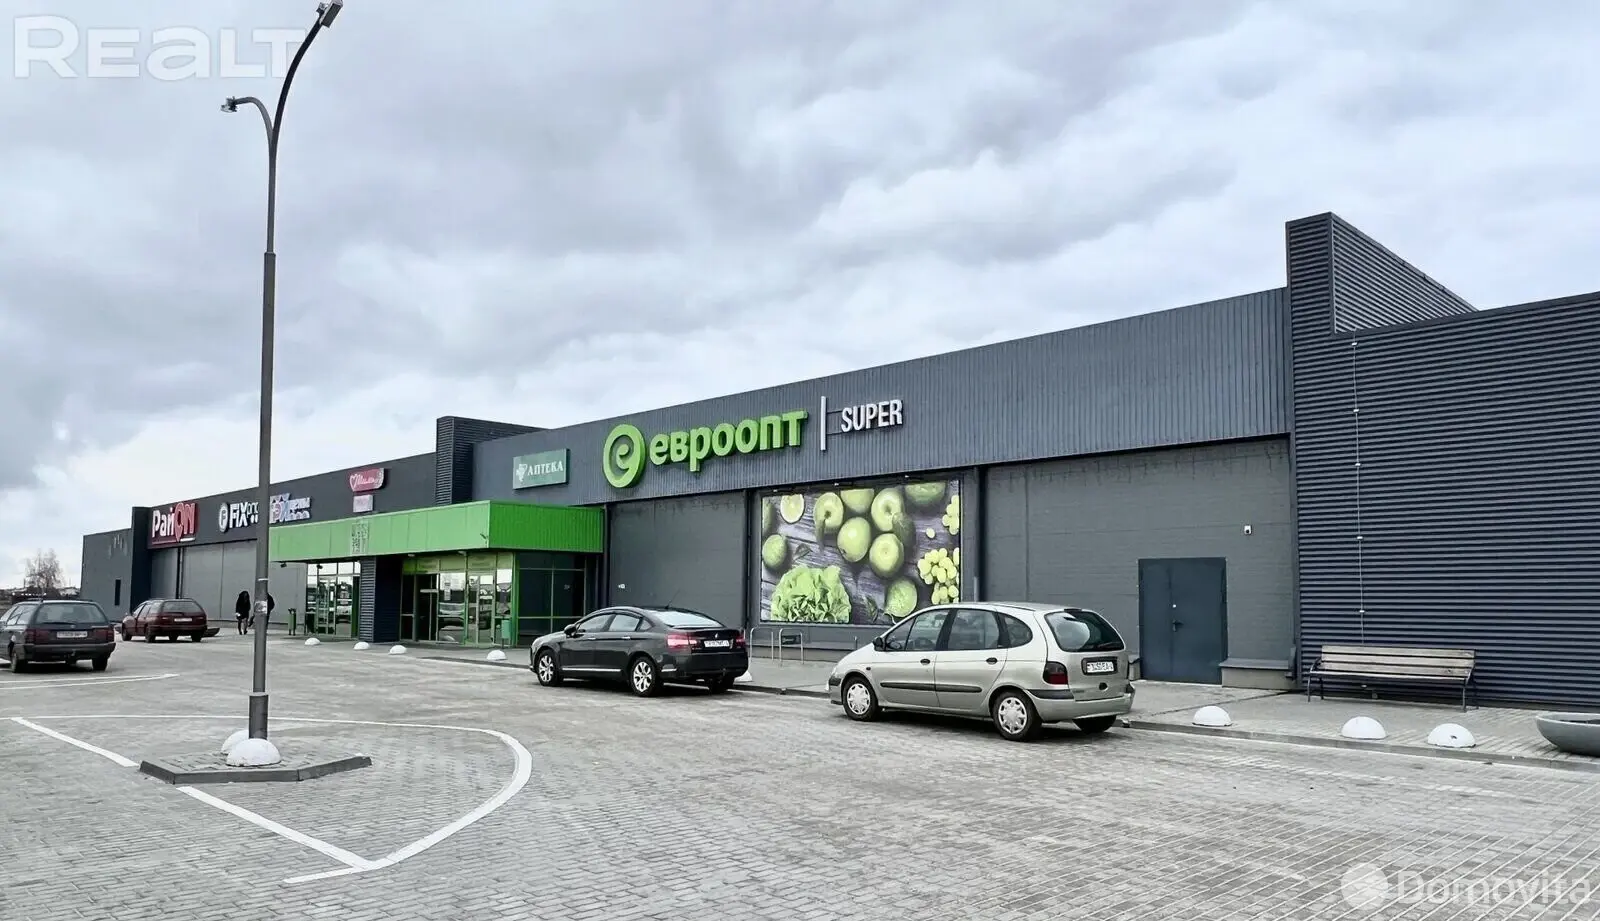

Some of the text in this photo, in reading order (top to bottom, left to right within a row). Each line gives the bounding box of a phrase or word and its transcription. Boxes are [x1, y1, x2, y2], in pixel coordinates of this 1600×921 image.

[649, 410, 809, 472] евроопт
[840, 398, 904, 433] SUPER
[527, 460, 564, 477] АПТЕКА
[228, 502, 249, 529] FIX
